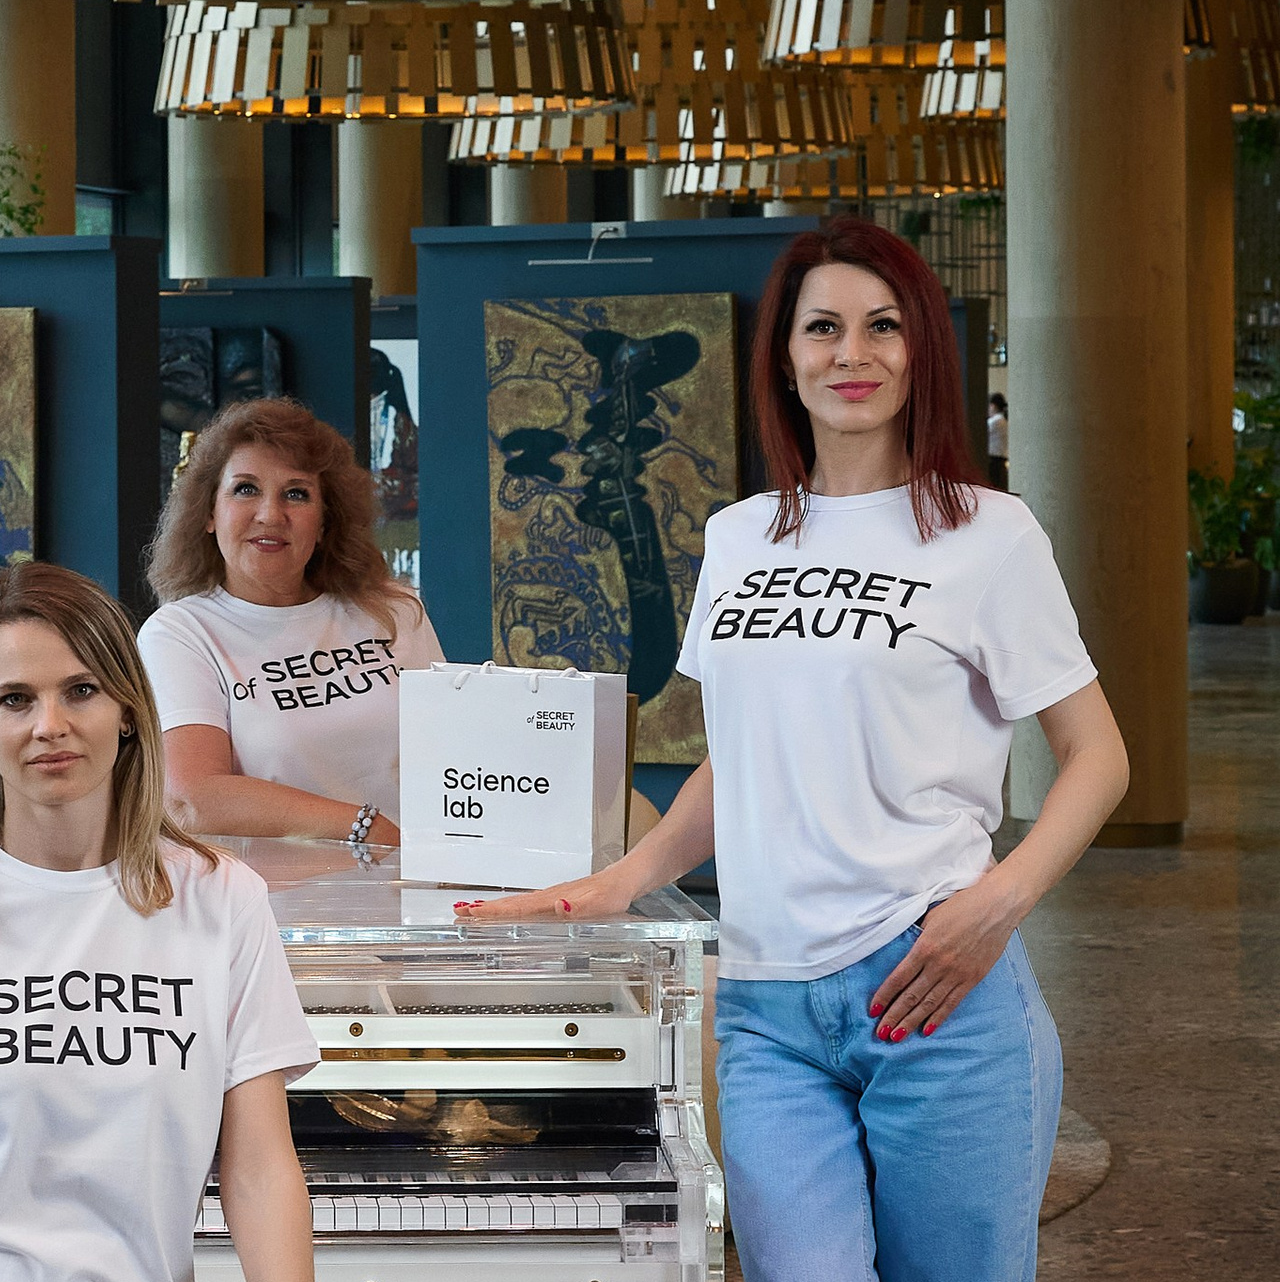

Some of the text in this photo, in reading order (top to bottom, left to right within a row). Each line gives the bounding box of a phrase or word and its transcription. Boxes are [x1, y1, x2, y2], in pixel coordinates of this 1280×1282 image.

[733, 566, 932, 609] SECRET
[710, 607, 918, 650] BEAUTY
[261, 638, 396, 683] SECRET
[526, 710, 575, 724] of SECRET
[536, 721, 576, 731] BEAUTY
[443, 767, 550, 795] Science
[443, 794, 484, 819] lab
